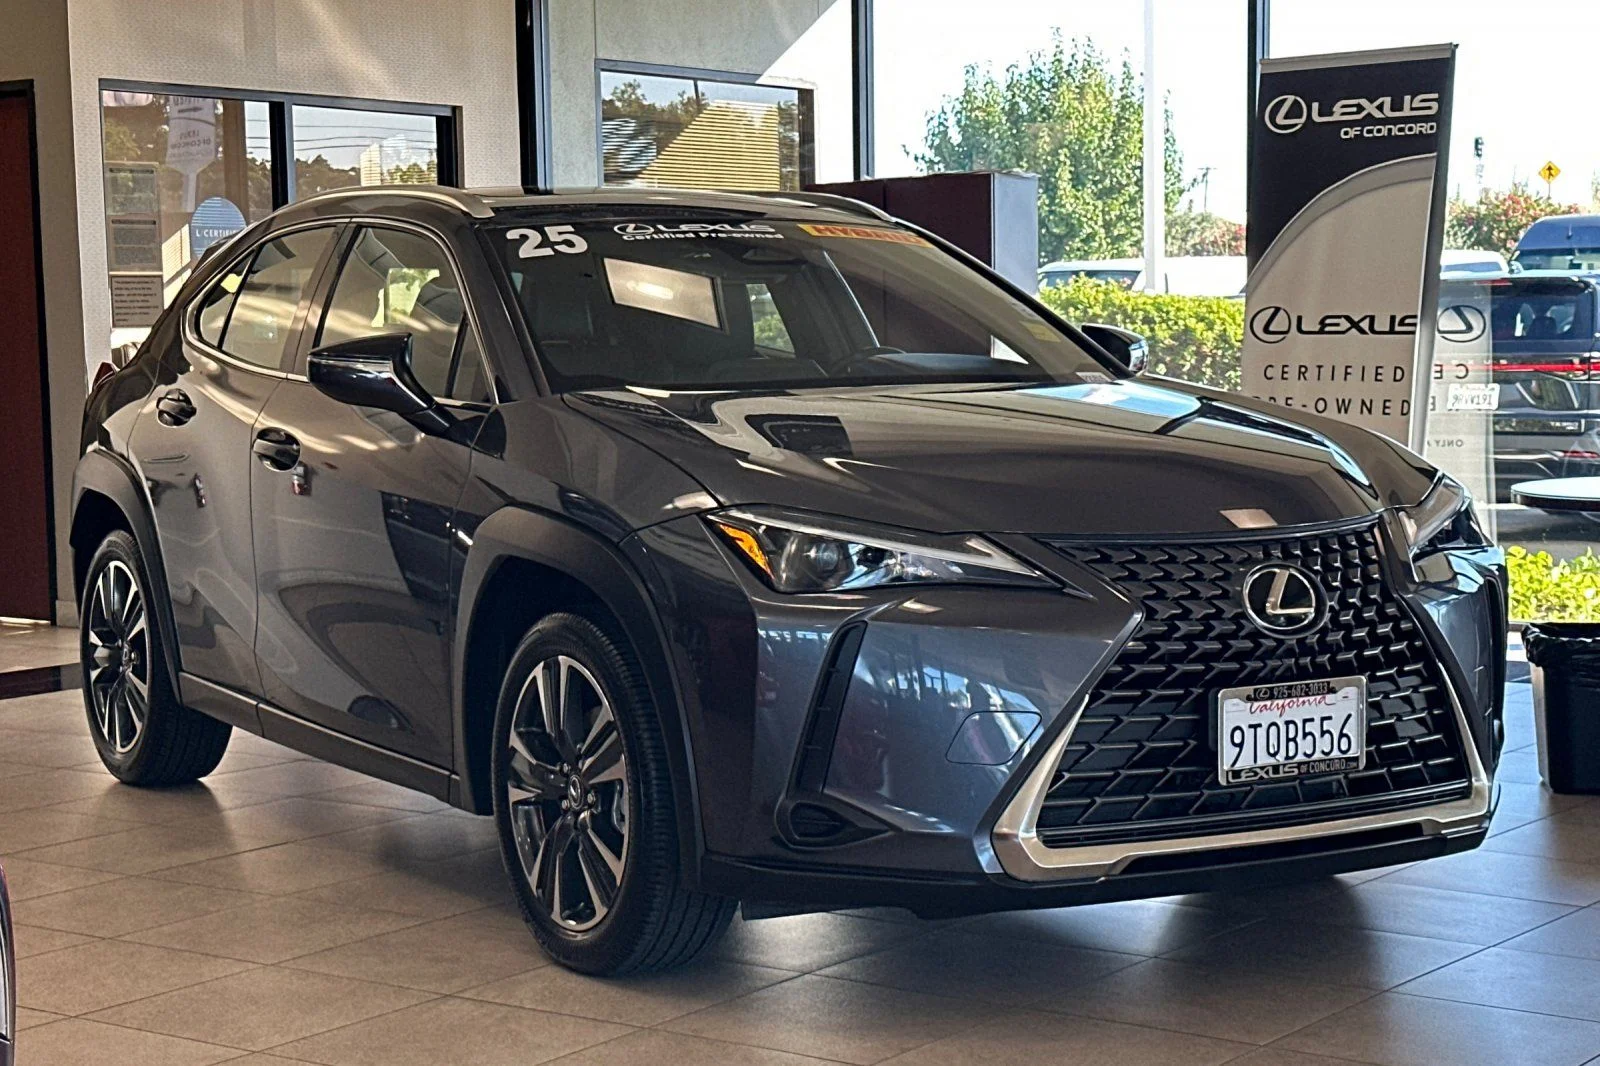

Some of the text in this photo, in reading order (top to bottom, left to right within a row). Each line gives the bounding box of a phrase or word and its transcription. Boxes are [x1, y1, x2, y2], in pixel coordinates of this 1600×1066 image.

[1311, 93, 1439, 123] LEXUS
[1340, 122, 1437, 139] OF CONCORD
[622, 232, 696, 241] Certified
[656, 223, 776, 232] LEXUS
[506, 224, 588, 259] 25
[1296, 314, 1418, 335] LEXUS
[1263, 364, 1405, 382] CERTIFIED
[1252, 396, 1411, 416] E-OWNED
[1273, 682, 1328, 699] 925-682-3033
[1230, 713, 1353, 768] 9TQB556
[1227, 763, 1299, 783] LEXUS
